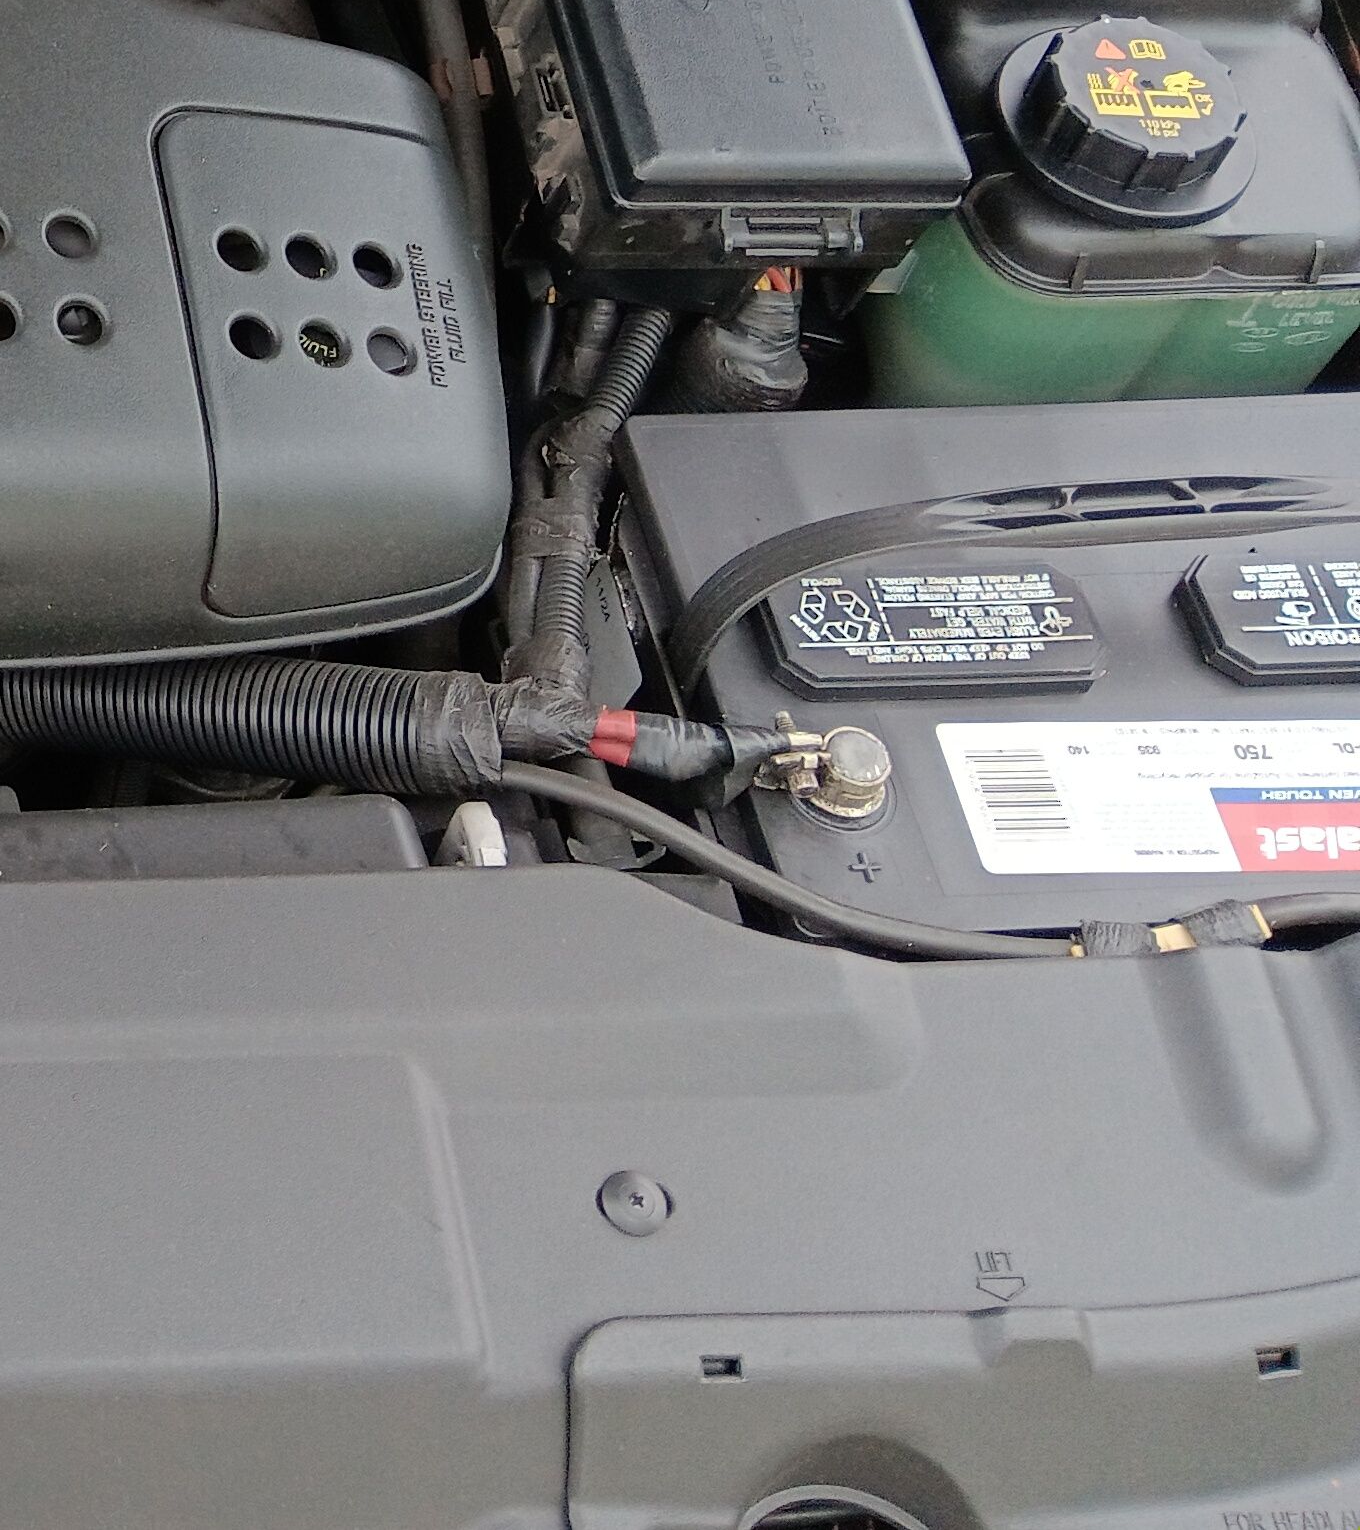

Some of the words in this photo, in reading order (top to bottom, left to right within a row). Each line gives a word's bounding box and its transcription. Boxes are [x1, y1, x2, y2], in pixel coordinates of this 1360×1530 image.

[1285, 630, 1360, 647] POISON
[1234, 745, 1274, 760] 750
[1262, 790, 1325, 801] TOUGH
